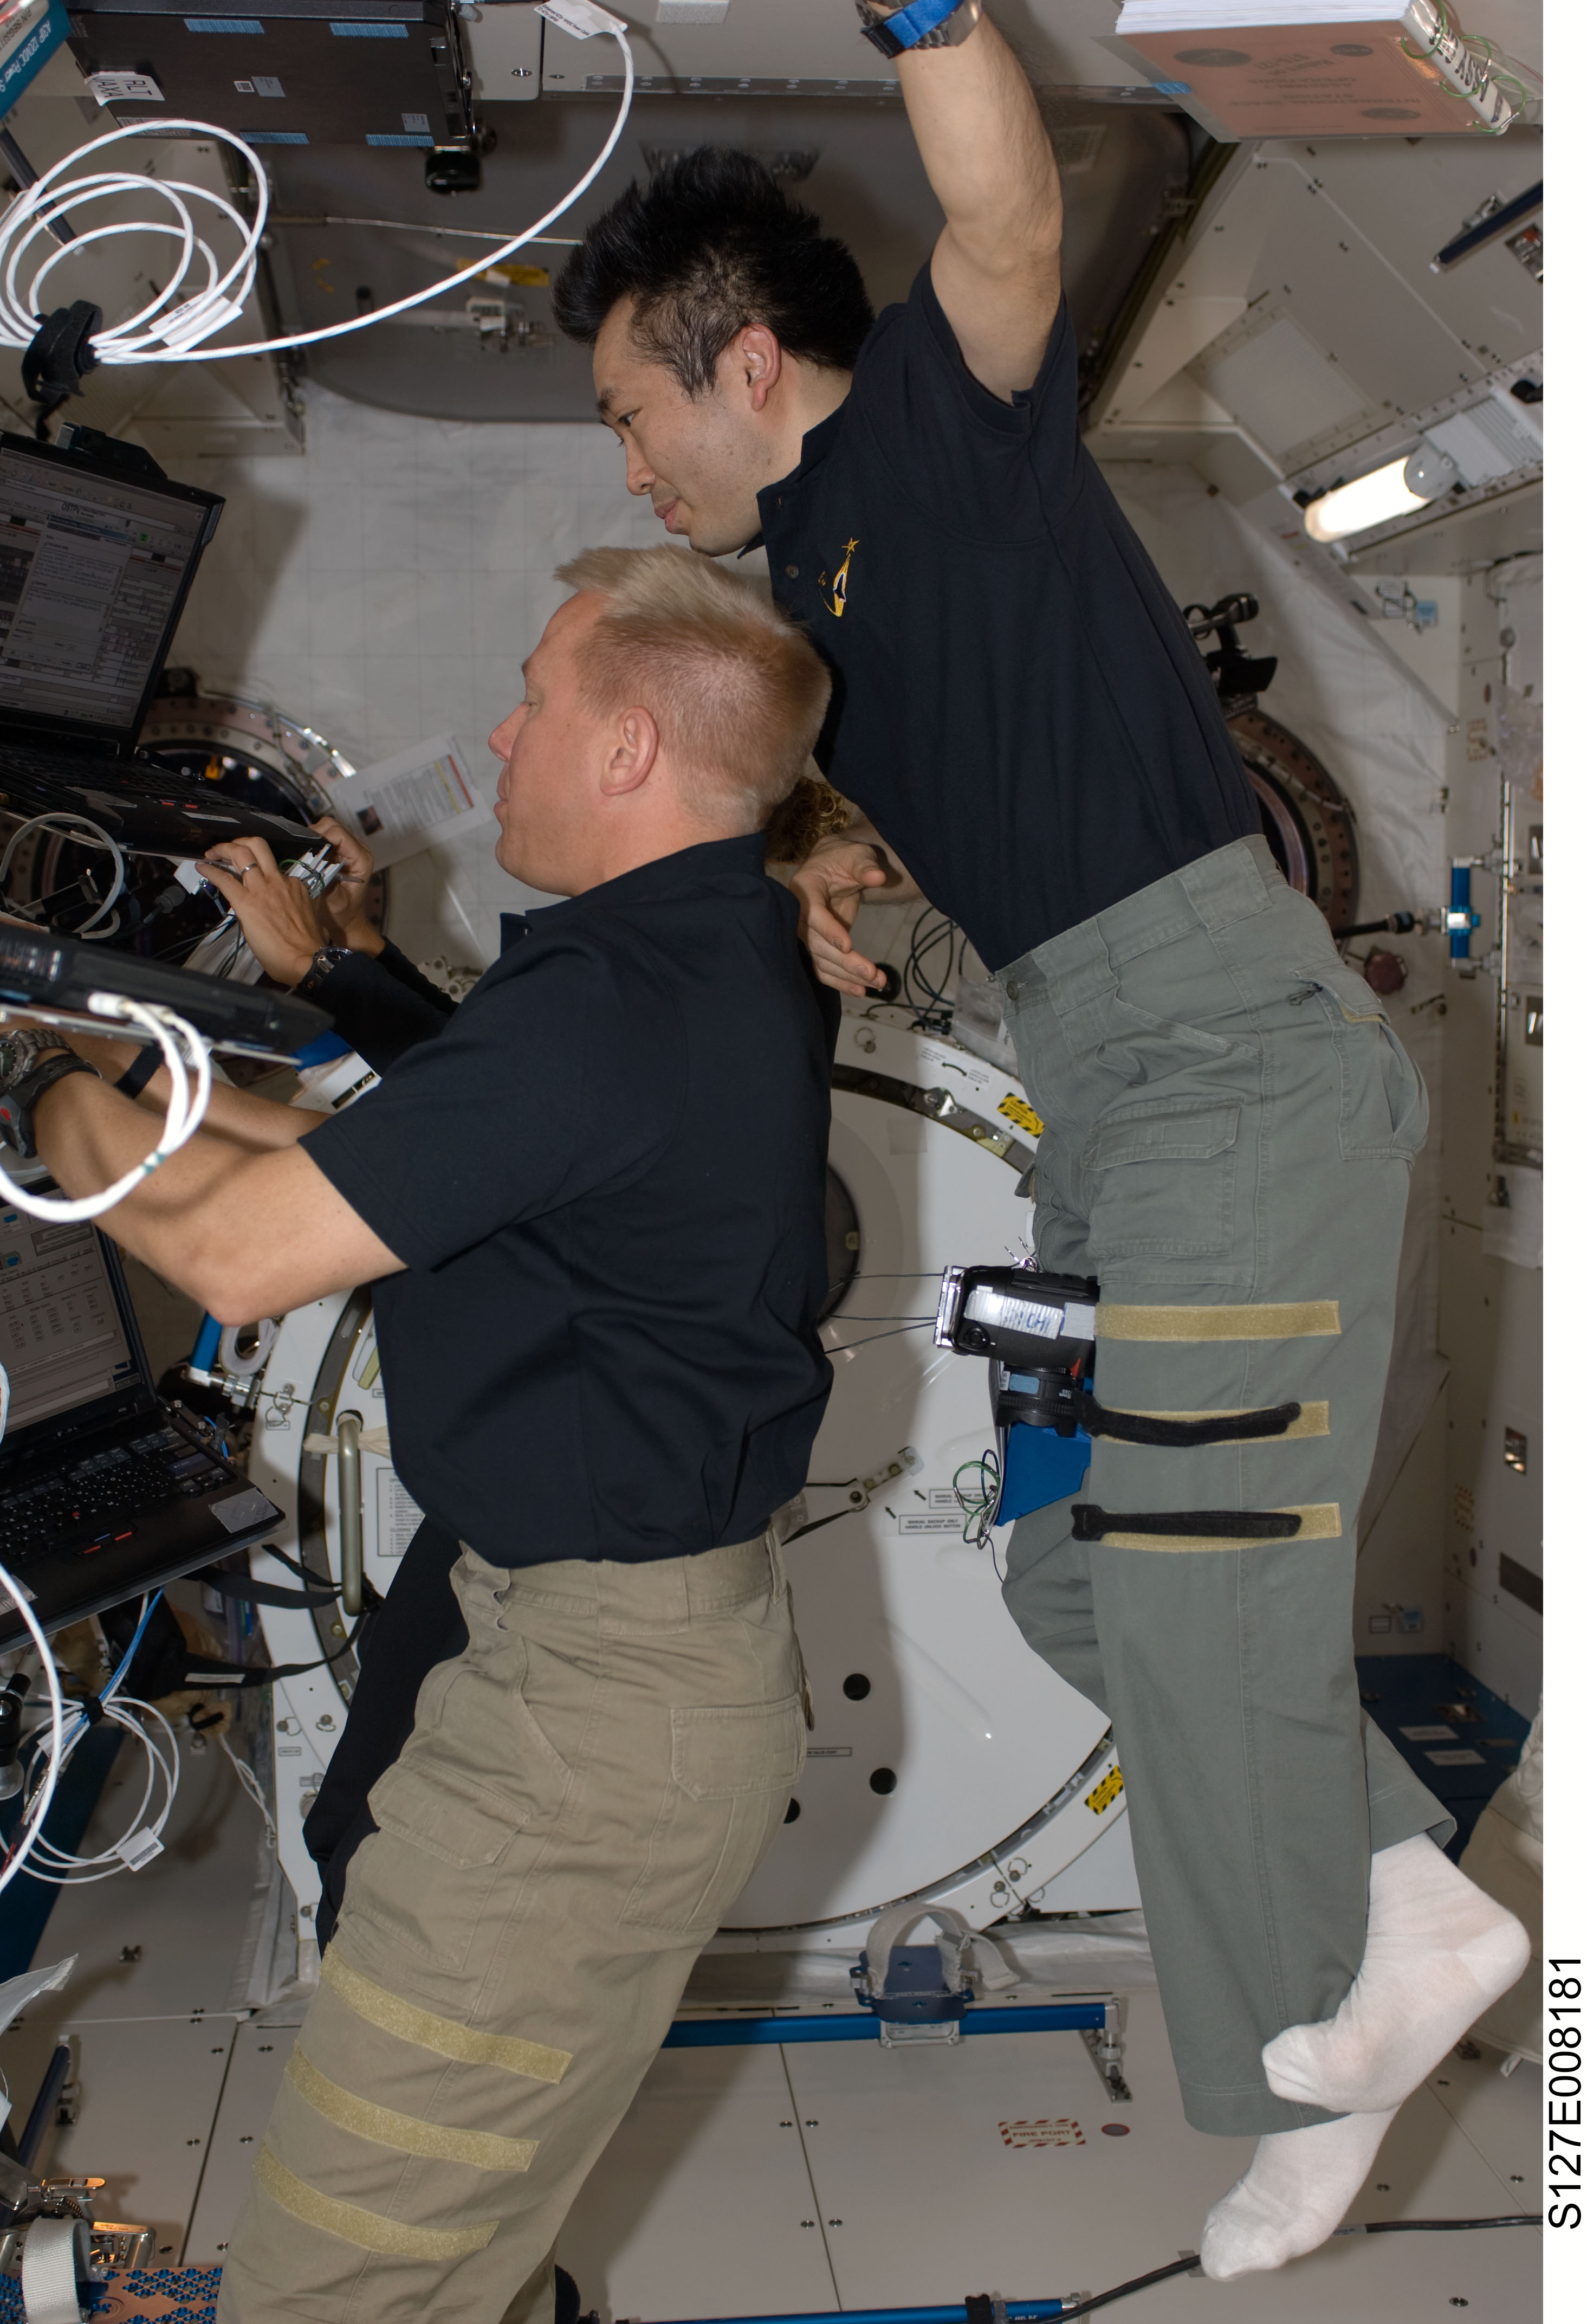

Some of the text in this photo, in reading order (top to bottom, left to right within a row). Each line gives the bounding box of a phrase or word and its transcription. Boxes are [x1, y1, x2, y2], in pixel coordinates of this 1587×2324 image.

[4, 60, 22, 83] Power
[92, 76, 125, 98] JAXA
[123, 80, 152, 96] RLT
